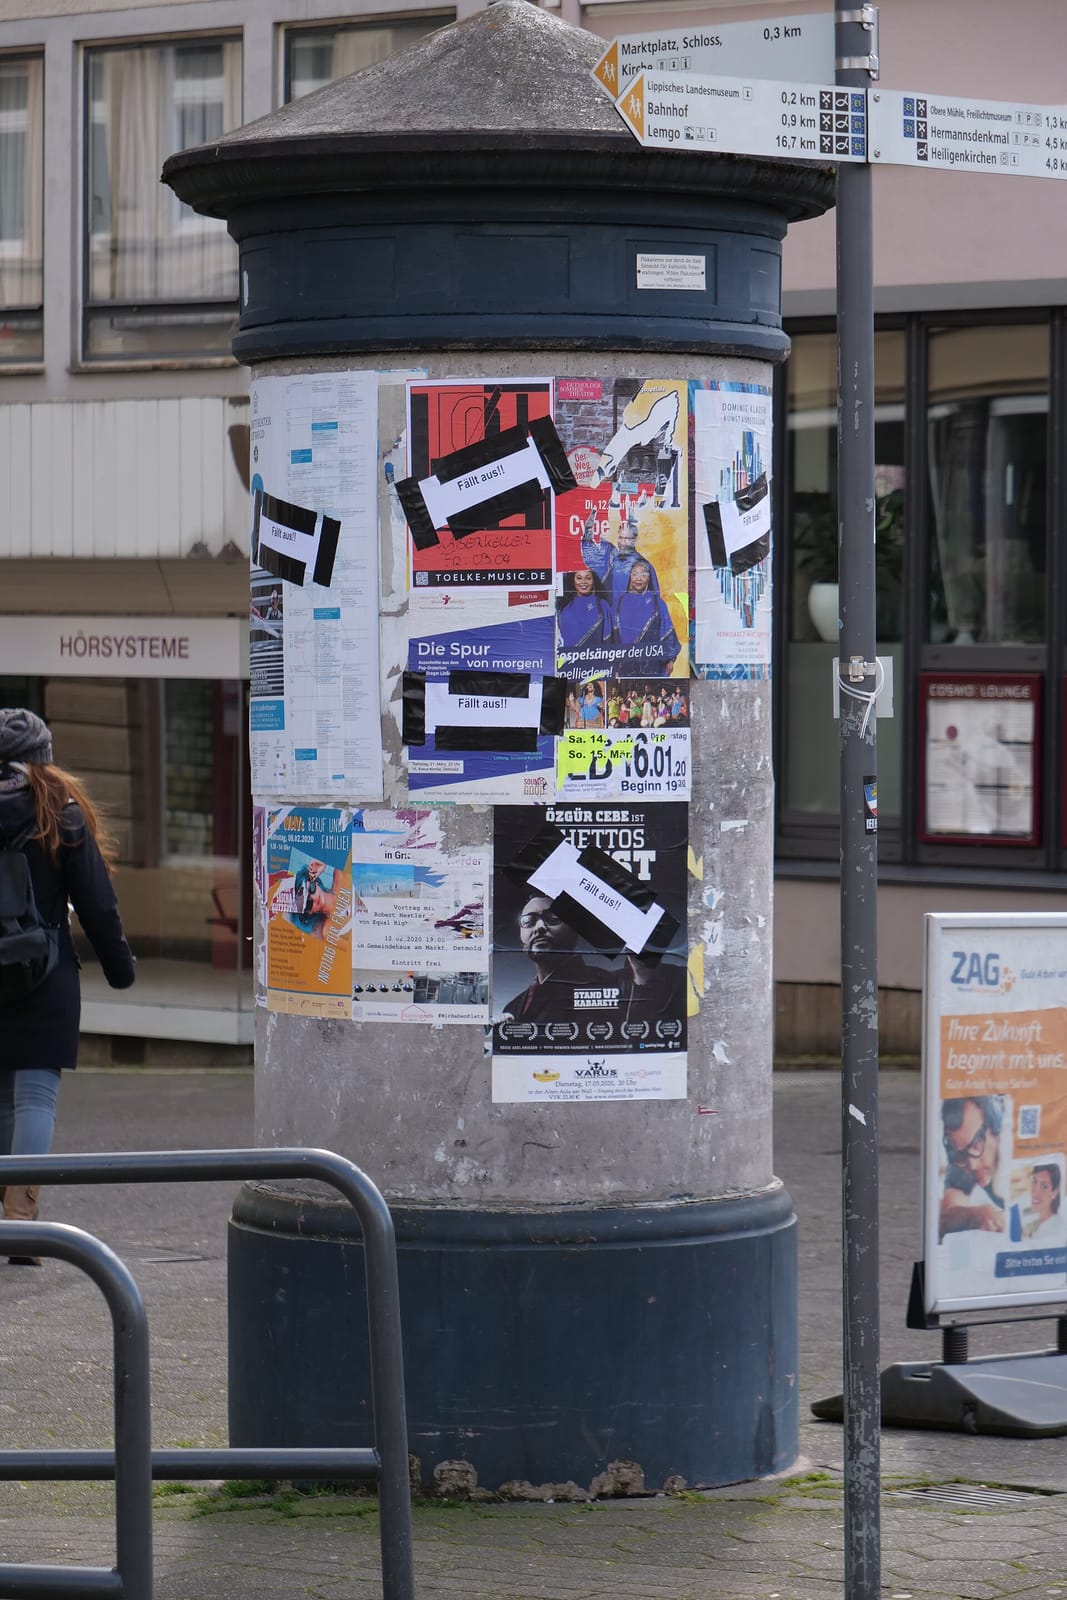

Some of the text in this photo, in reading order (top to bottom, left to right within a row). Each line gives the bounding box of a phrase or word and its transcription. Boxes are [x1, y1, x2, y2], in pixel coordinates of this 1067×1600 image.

[764, 26, 801, 40] 0,3 km
[622, 34, 722, 56] Marktplatz, Schloss,
[622, 62, 652, 76] Kirche
[648, 80, 740, 98] Lippisches Landesmuseum
[782, 92, 816, 106] 0,2 km
[648, 102, 688, 118] Bahnhof
[930, 106, 946, 116] Obere
[966, 110, 1012, 122] Freilichtmuseum
[782, 114, 816, 128] 0,9 km
[1046, 116, 1057, 129] 1,3
[648, 124, 680, 142] Lemgo
[931, 126, 1009, 144] Hermannsdenkmal
[776, 135, 816, 150] 16,7 km
[1046, 137, 1057, 150] 4,5
[931, 148, 996, 164] Heiligenkirchen
[1046, 158, 1058, 172] 4,8
[574, 453, 587, 462] Der
[574, 461, 591, 470] Weg
[457, 465, 504, 491] Fällt aus!!
[436, 572, 546, 582] TOELKE-MUSIC.DE
[60, 630, 190, 659] HÖRSYSTEME
[418, 642, 490, 659] Die Spur
[628, 646, 644, 658] der
[645, 645, 664, 657] USA
[467, 659, 543, 671] von morgen!
[928, 684, 1030, 698] COSMO LOUNGE
[459, 698, 507, 708] Fällt aus!!
[569, 735, 606, 743] Sa. 14.
[569, 750, 586, 759] So.
[590, 750, 606, 759] 15.
[621, 781, 661, 793] Beginn
[545, 808, 644, 822] ÖZGÜR CEBE IST
[308, 816, 326, 832] BERUF
[322, 835, 348, 852] FAMILIE!
[384, 850, 392, 859] in
[579, 878, 622, 911] Fällt aus!!
[951, 952, 999, 986] ZAG
[602, 988, 619, 998] UP
[574, 999, 619, 1007] KABARETT
[948, 1020, 1042, 1047] Ihre Zukunft
[946, 1048, 1005, 1074] beginnt
[1008, 1050, 1034, 1069] mit
